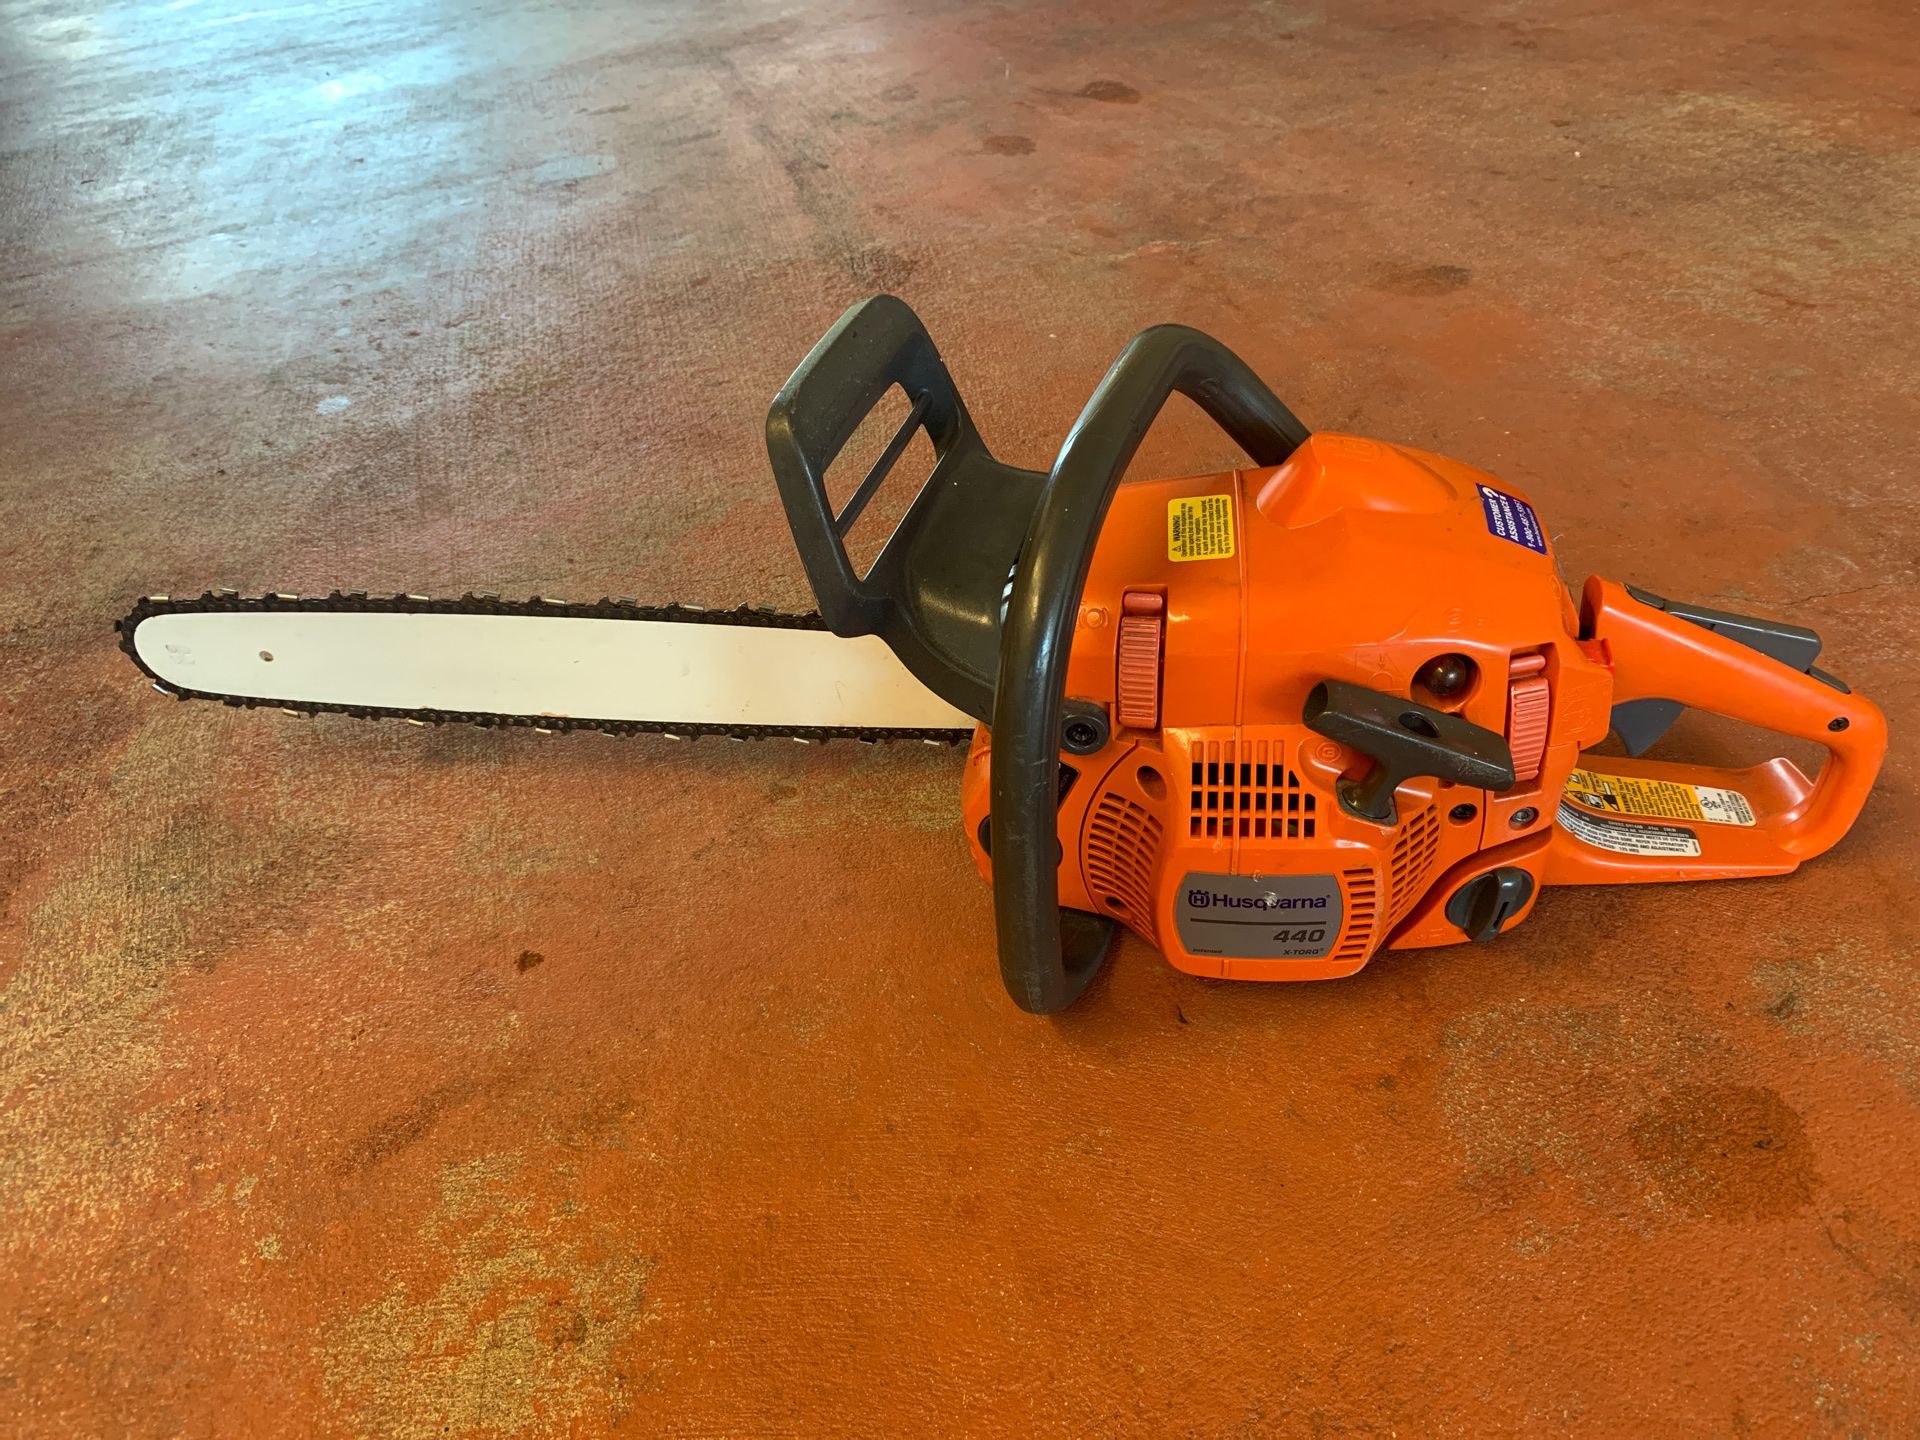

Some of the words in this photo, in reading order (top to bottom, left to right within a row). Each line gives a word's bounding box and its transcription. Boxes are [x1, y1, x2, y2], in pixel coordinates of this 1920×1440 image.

[1489, 499, 1506, 536] CUSTOMER
[1501, 500, 1519, 541] ASSISTANCE
[1212, 894, 1326, 910] Husqvarna
[1273, 929, 1325, 943] 440
